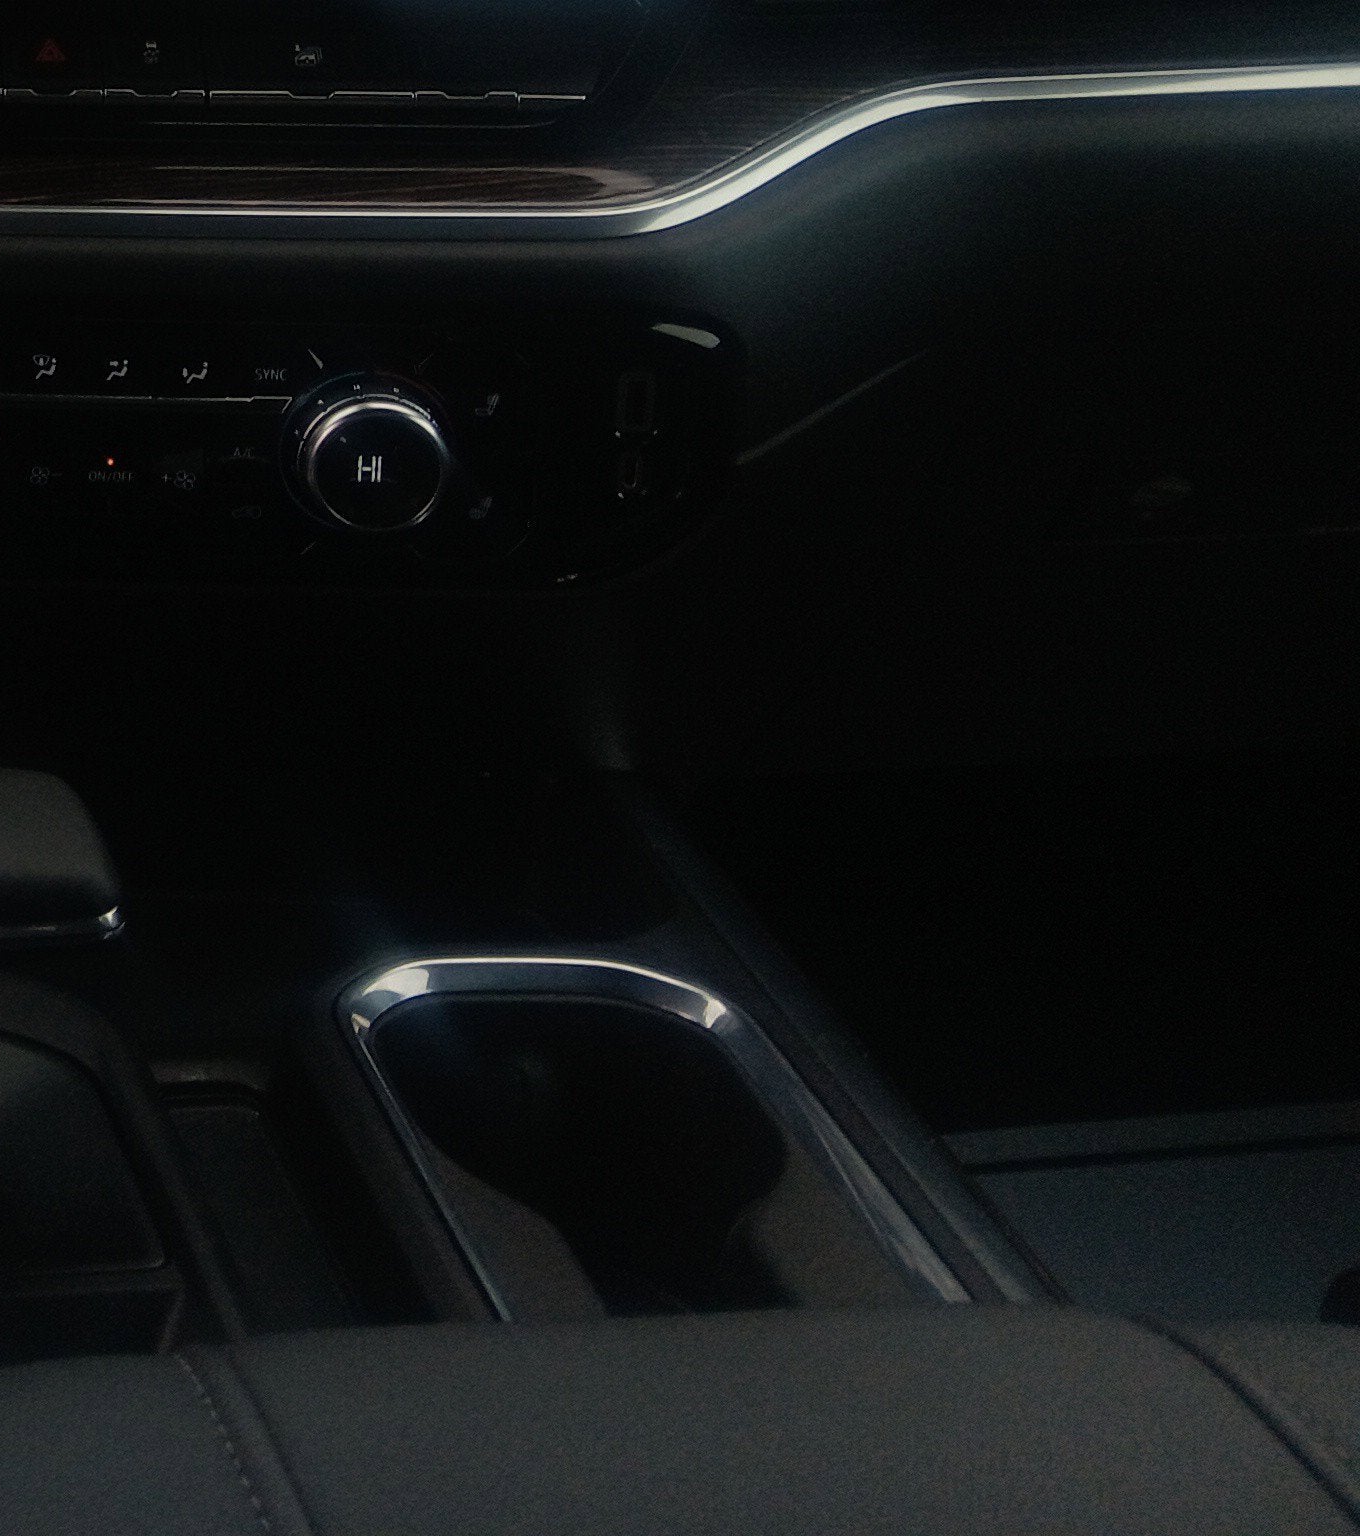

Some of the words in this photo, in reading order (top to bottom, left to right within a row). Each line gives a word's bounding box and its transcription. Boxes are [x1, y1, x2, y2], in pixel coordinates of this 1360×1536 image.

[254, 368, 287, 382] SYNC
[357, 455, 381, 483] HI
[87, 471, 135, 482] ON/OFF
